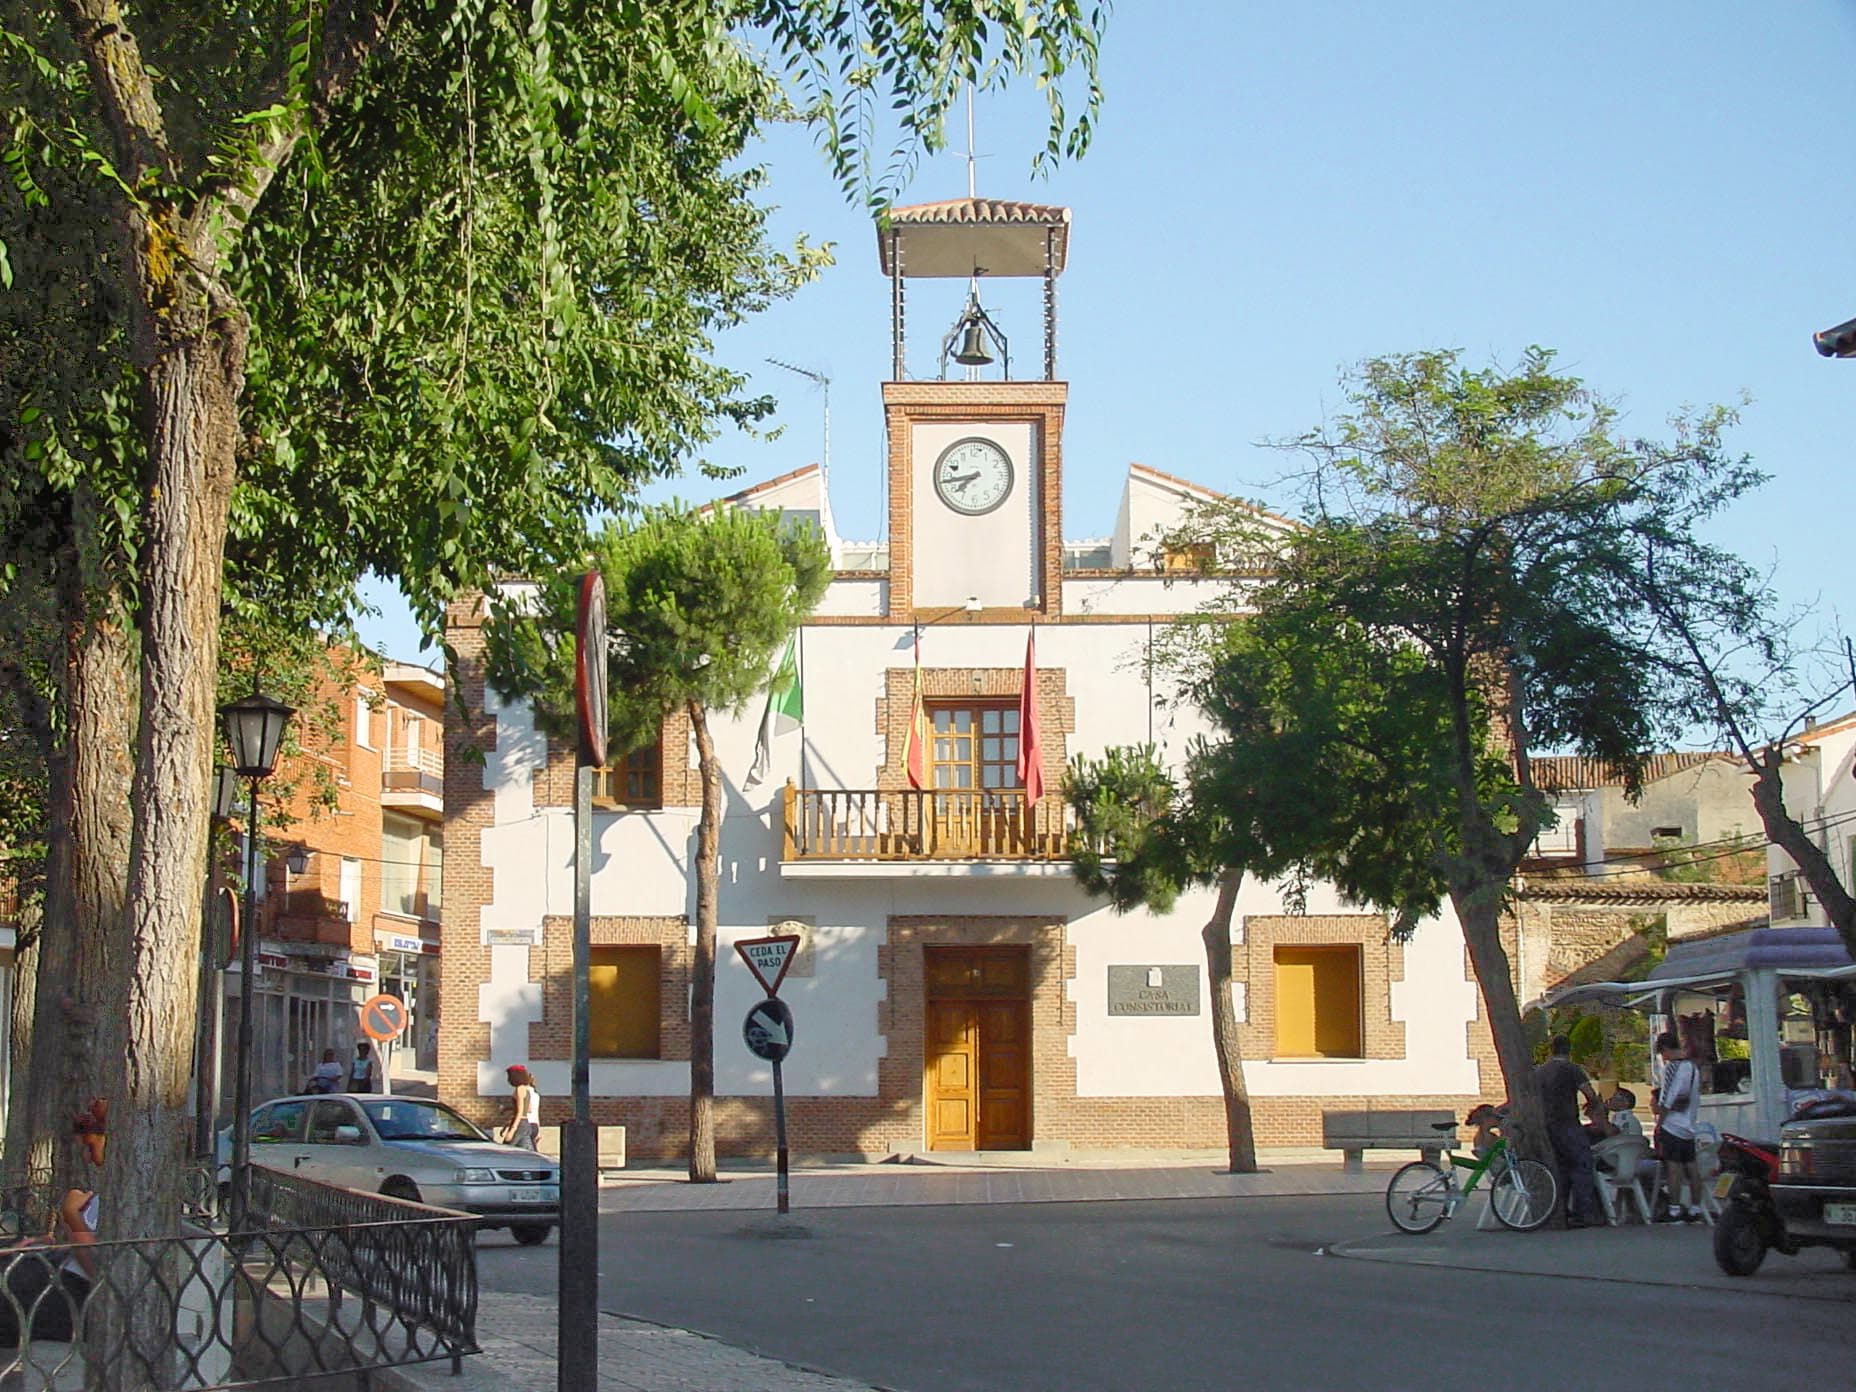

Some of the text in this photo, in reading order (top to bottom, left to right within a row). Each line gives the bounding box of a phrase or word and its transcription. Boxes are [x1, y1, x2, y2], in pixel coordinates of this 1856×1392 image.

[970, 447, 979, 458] 12
[992, 459, 999, 469] 2
[993, 483, 1000, 492] 4
[971, 494, 978, 504] 6
[983, 490, 990, 501] 5
[750, 945, 787, 957] CEDA EL
[758, 957, 782, 968] PASO
[1138, 990, 1169, 1001] CASA
